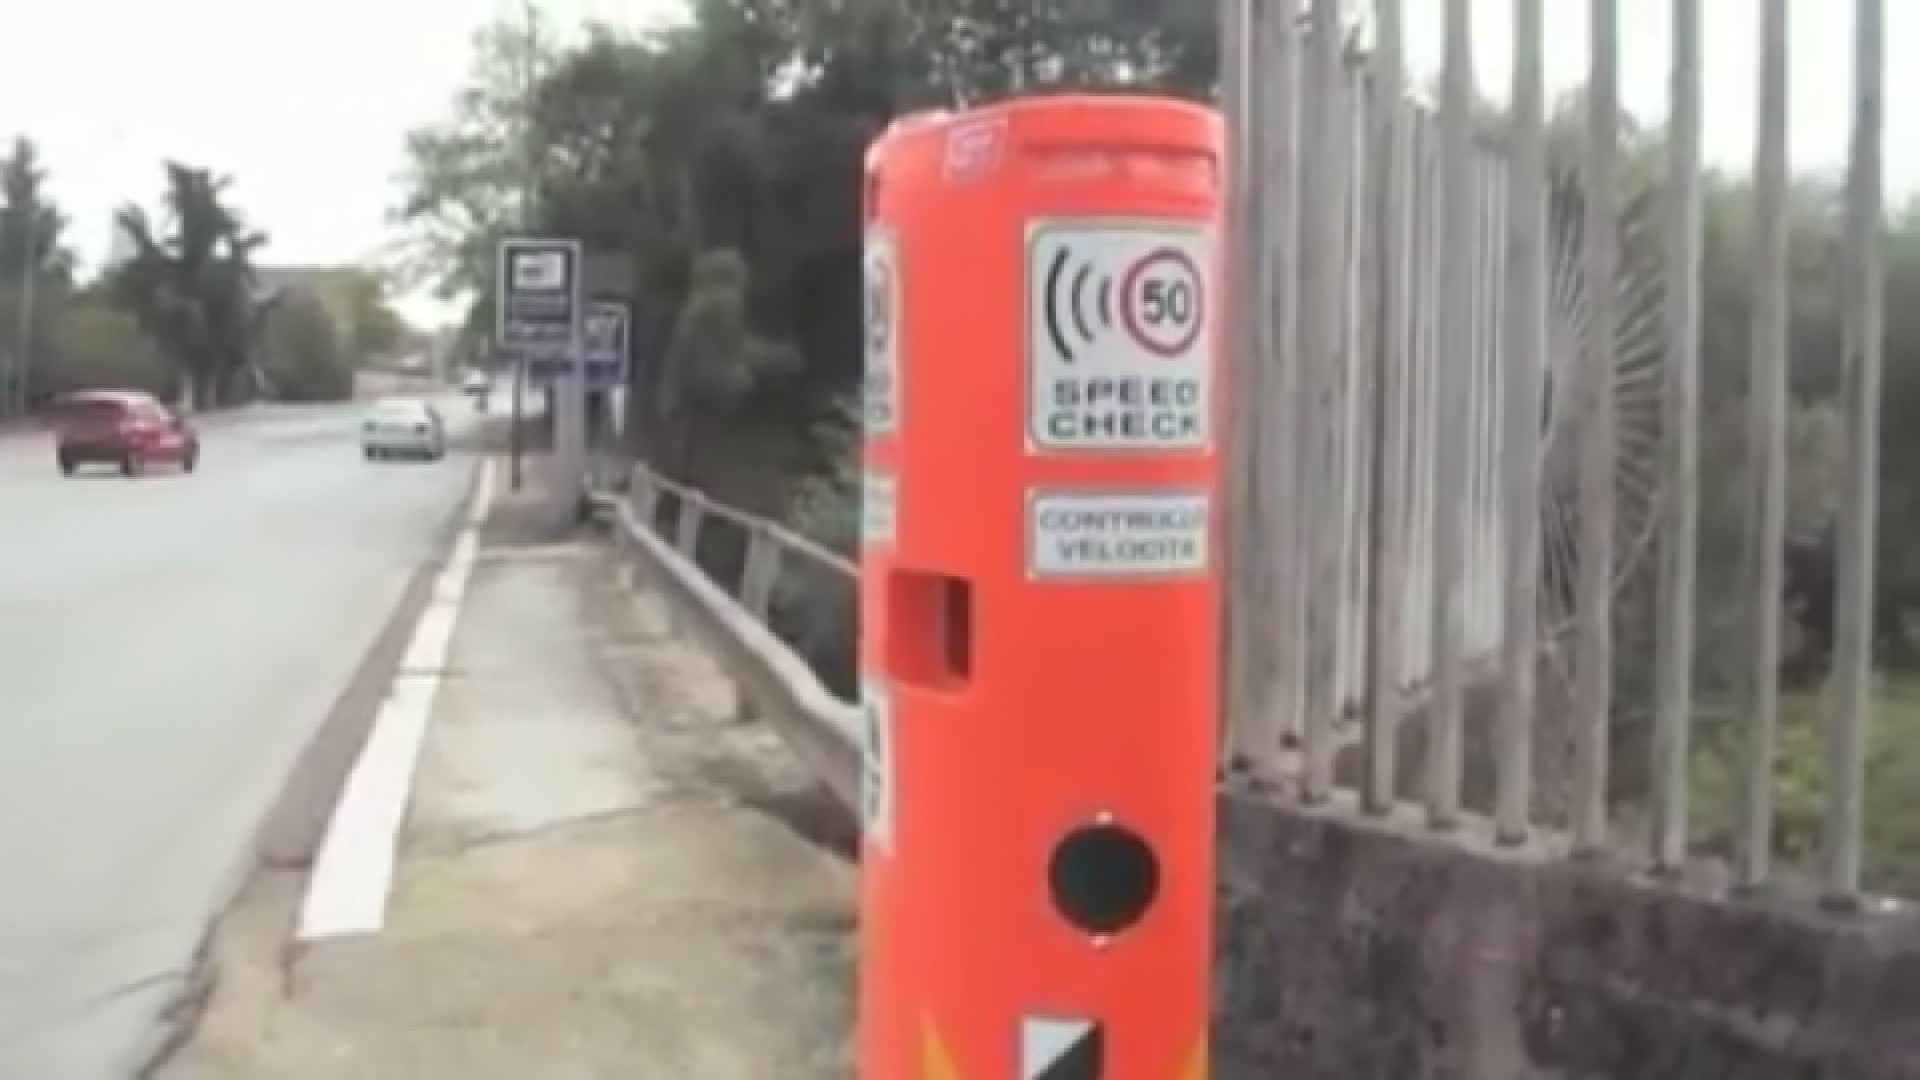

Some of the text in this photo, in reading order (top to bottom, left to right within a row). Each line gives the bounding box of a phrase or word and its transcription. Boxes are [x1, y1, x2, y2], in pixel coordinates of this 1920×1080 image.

[1142, 279, 1191, 325] 50
[1053, 378, 1199, 406] SPEED
[1047, 410, 1200, 439] CHECK
